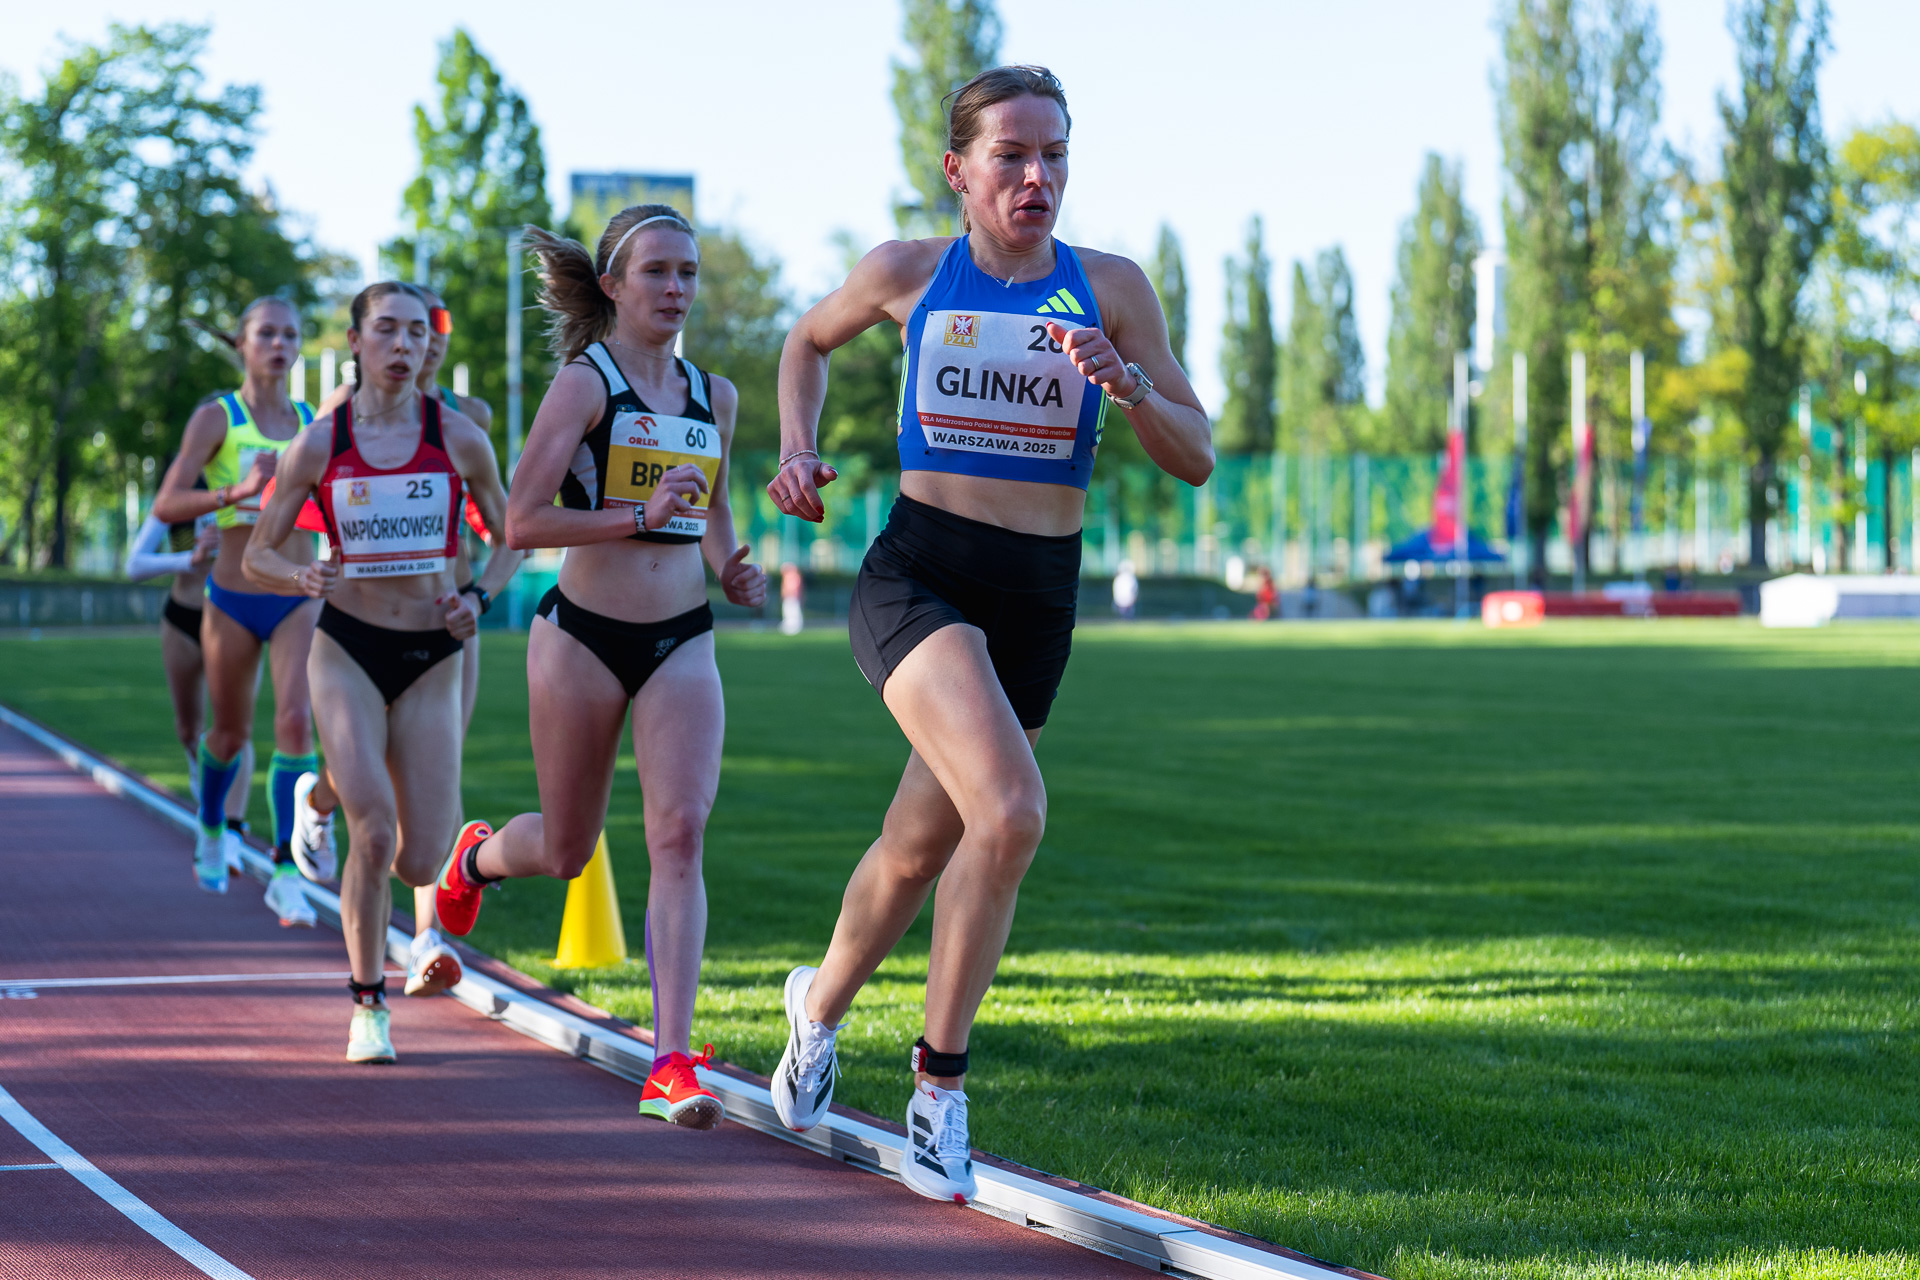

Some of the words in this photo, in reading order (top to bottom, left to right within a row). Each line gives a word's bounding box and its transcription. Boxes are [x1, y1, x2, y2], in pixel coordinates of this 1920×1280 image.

[946, 336, 975, 346] PZLA
[936, 366, 1063, 408] GLINKA
[936, 417, 972, 426] Mistrzostwa
[1000, 424, 1018, 432] Biegu
[628, 436, 658, 446] ORLEN
[686, 426, 706, 448] 60
[933, 432, 1020, 451] WARSZAWA
[1023, 442, 1056, 454] 2025
[630, 461, 678, 488] BR
[406, 480, 433, 500] 25
[342, 513, 444, 541] NAPIÓRKOWSKA
[684, 522, 698, 531] 2025
[356, 562, 414, 574] WARSZAWA
[416, 560, 434, 570] 2025
